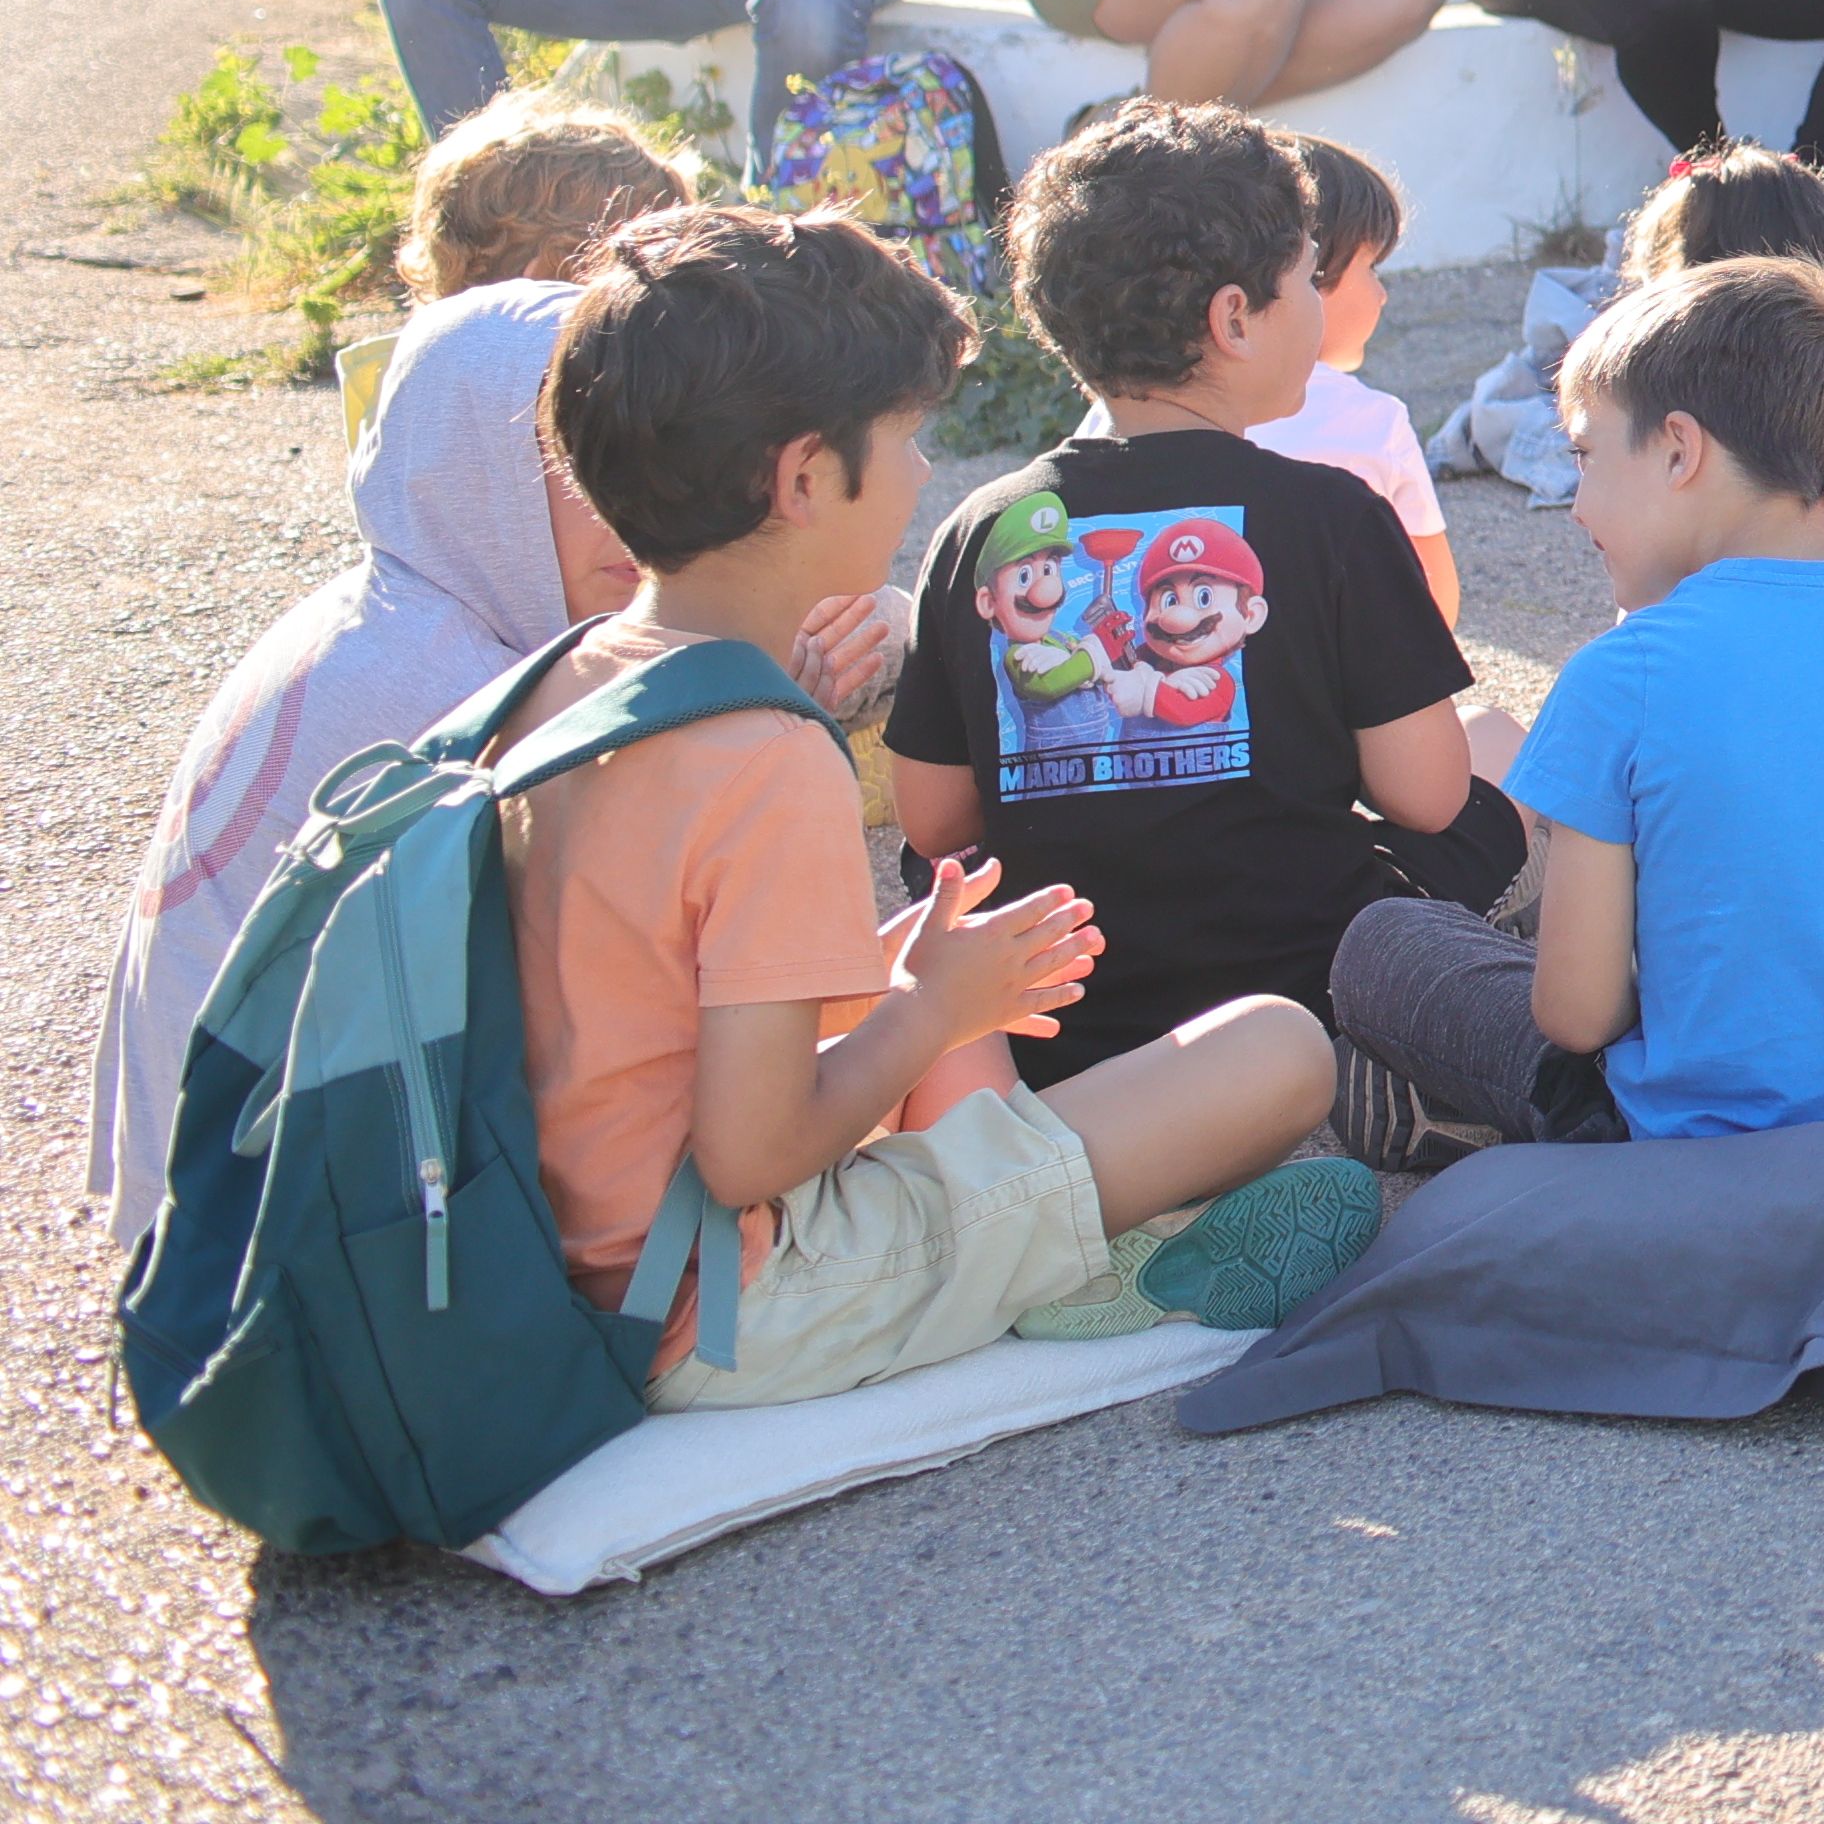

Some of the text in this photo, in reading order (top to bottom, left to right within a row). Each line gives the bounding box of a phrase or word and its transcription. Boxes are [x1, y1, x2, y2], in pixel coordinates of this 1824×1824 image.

[1172, 539, 1200, 560] M
[999, 741, 1251, 793] MARIO BROTHERS
